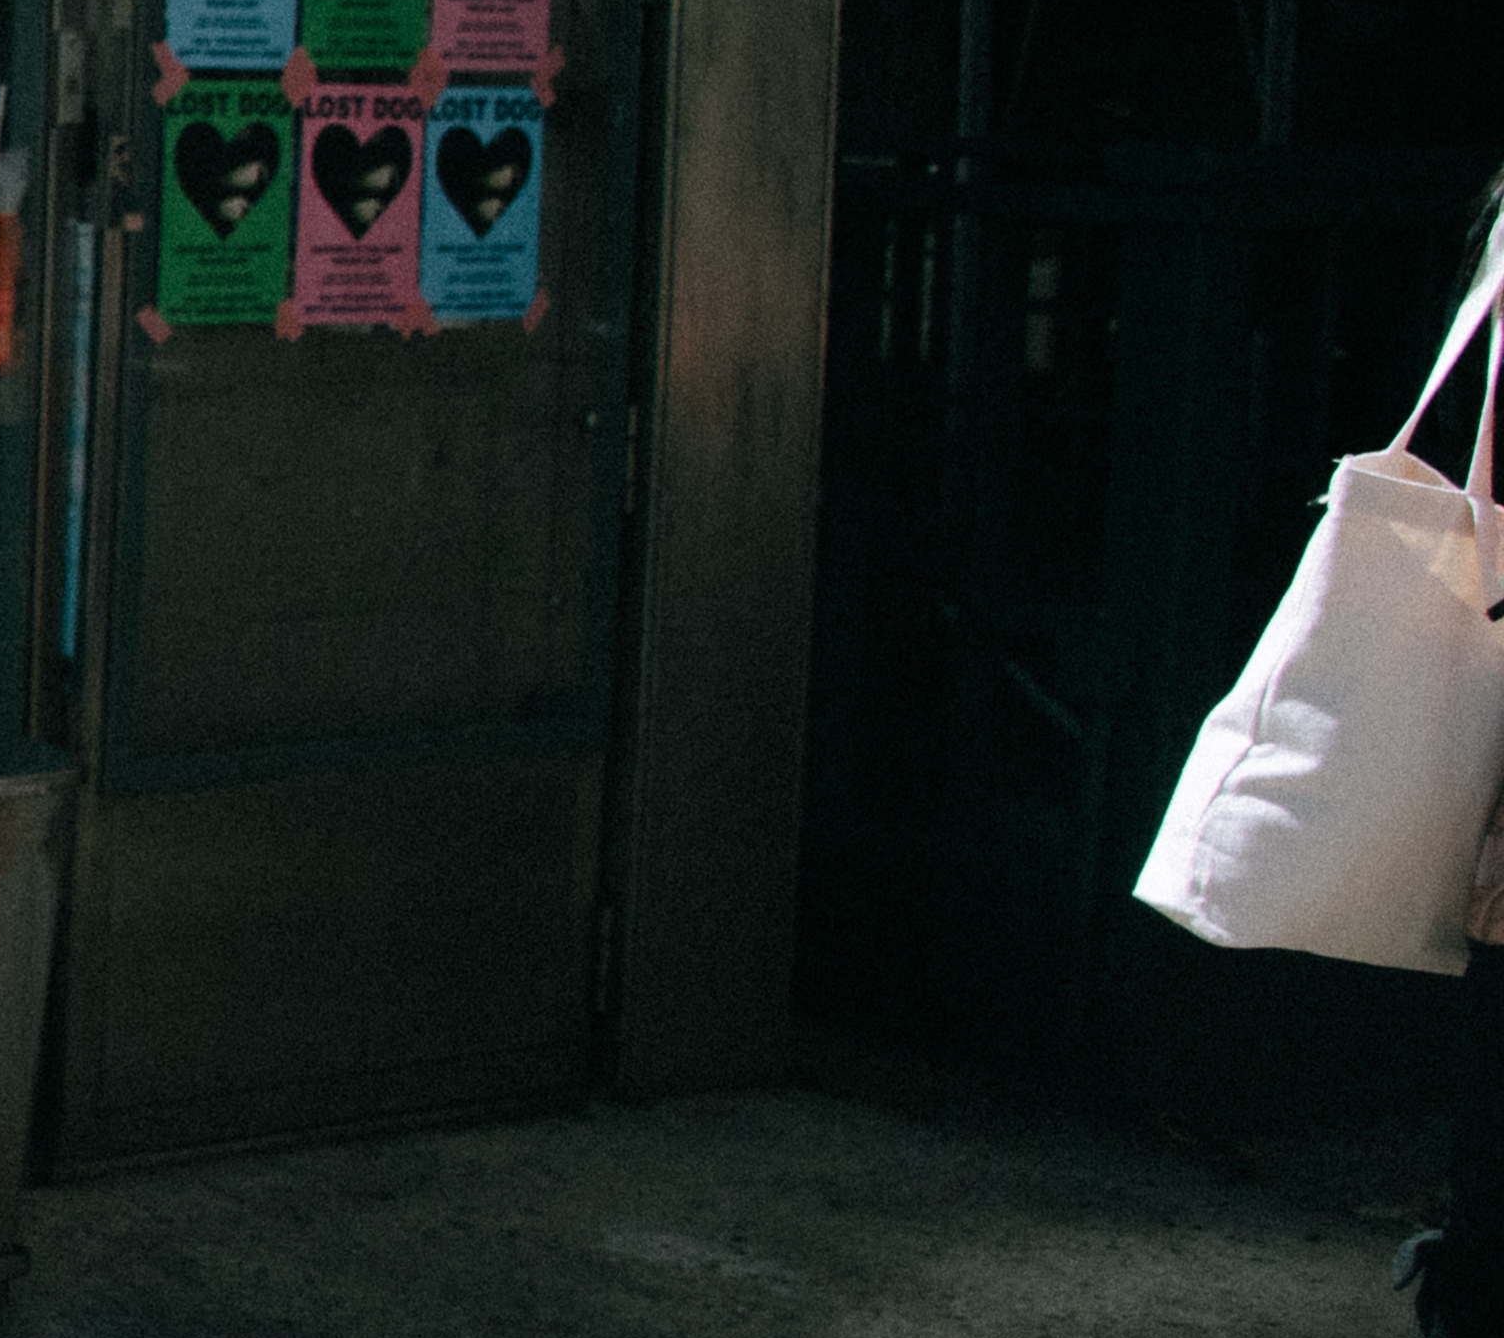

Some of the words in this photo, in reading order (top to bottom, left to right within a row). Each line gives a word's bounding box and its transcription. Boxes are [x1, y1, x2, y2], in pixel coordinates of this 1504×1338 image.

[167, 90, 230, 116] LOST
[237, 92, 289, 116] DOG
[305, 97, 365, 119] LOST
[373, 97, 424, 120] DOG
[431, 99, 486, 123] LOST
[493, 100, 544, 123] DOG
